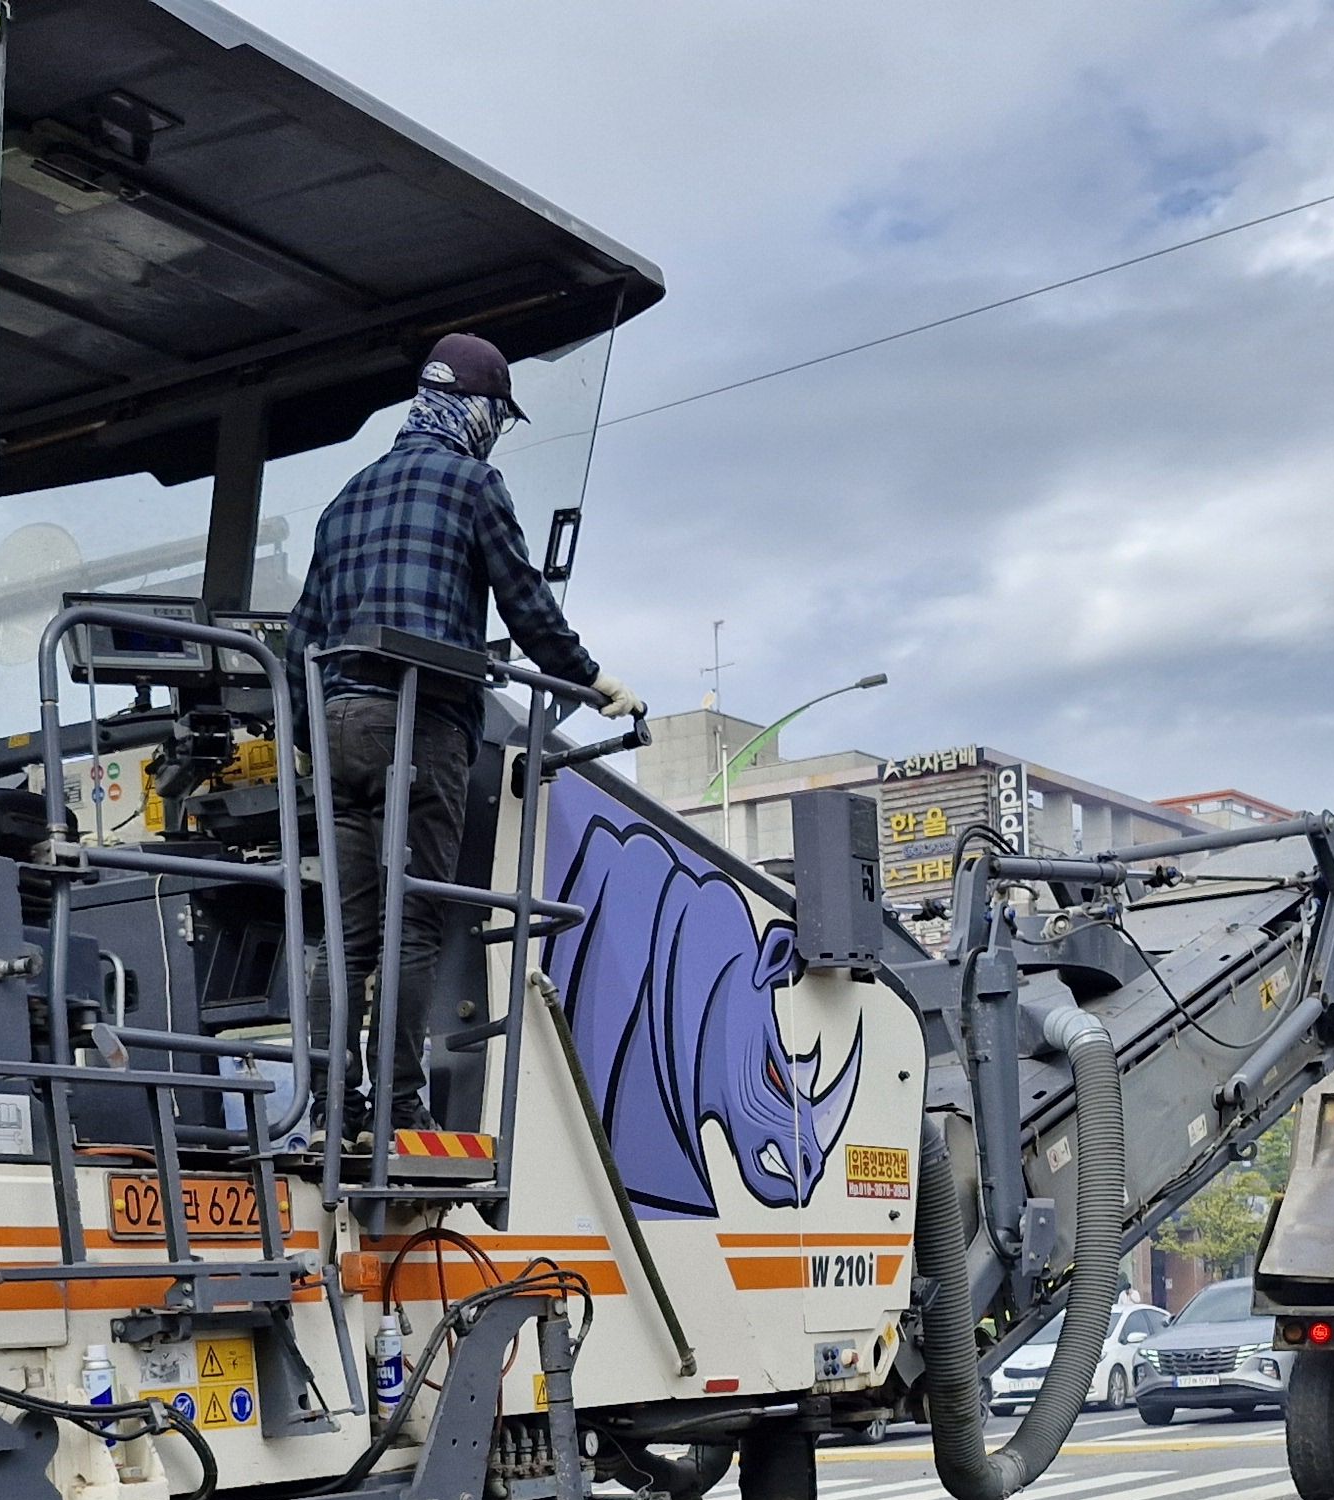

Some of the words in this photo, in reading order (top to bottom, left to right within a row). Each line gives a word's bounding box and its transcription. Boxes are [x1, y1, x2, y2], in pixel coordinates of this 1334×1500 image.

[903, 744, 977, 777] 전자담배
[999, 769, 1022, 853] adida
[812, 1256, 830, 1288] W
[834, 1251, 874, 1287] 210i
